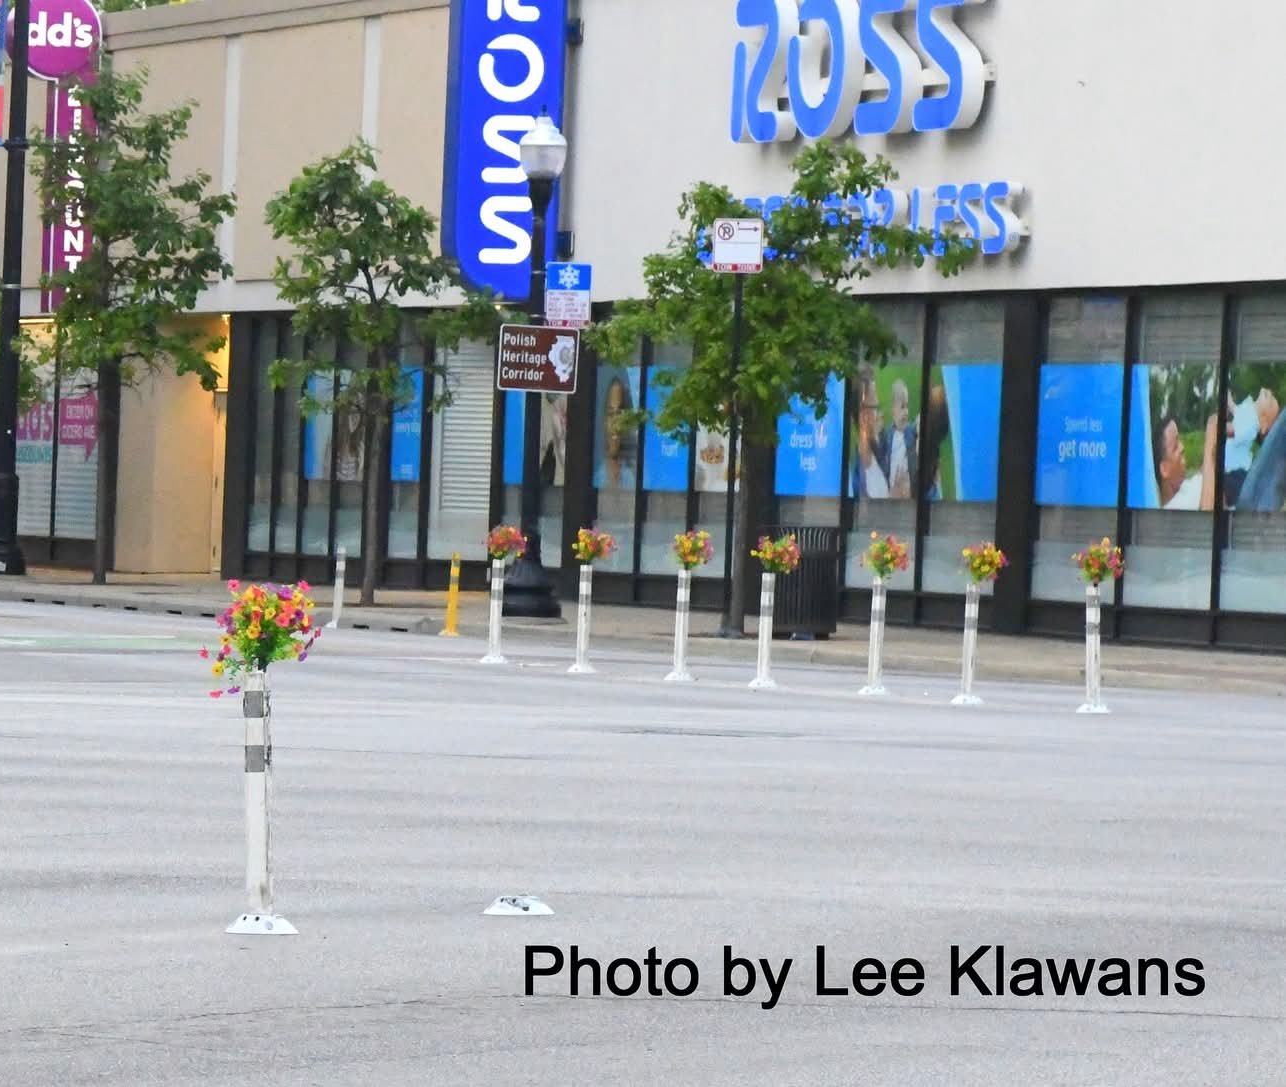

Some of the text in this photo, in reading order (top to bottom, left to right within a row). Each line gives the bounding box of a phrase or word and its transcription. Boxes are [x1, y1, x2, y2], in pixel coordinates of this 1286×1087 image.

[28, 11, 93, 48] dd's
[503, 333, 537, 346] Polish
[502, 351, 547, 367] Heritage
[501, 367, 544, 381] Corridor
[790, 432, 813, 449] dress
[1058, 440, 1107, 462] get more
[800, 453, 818, 471] less
